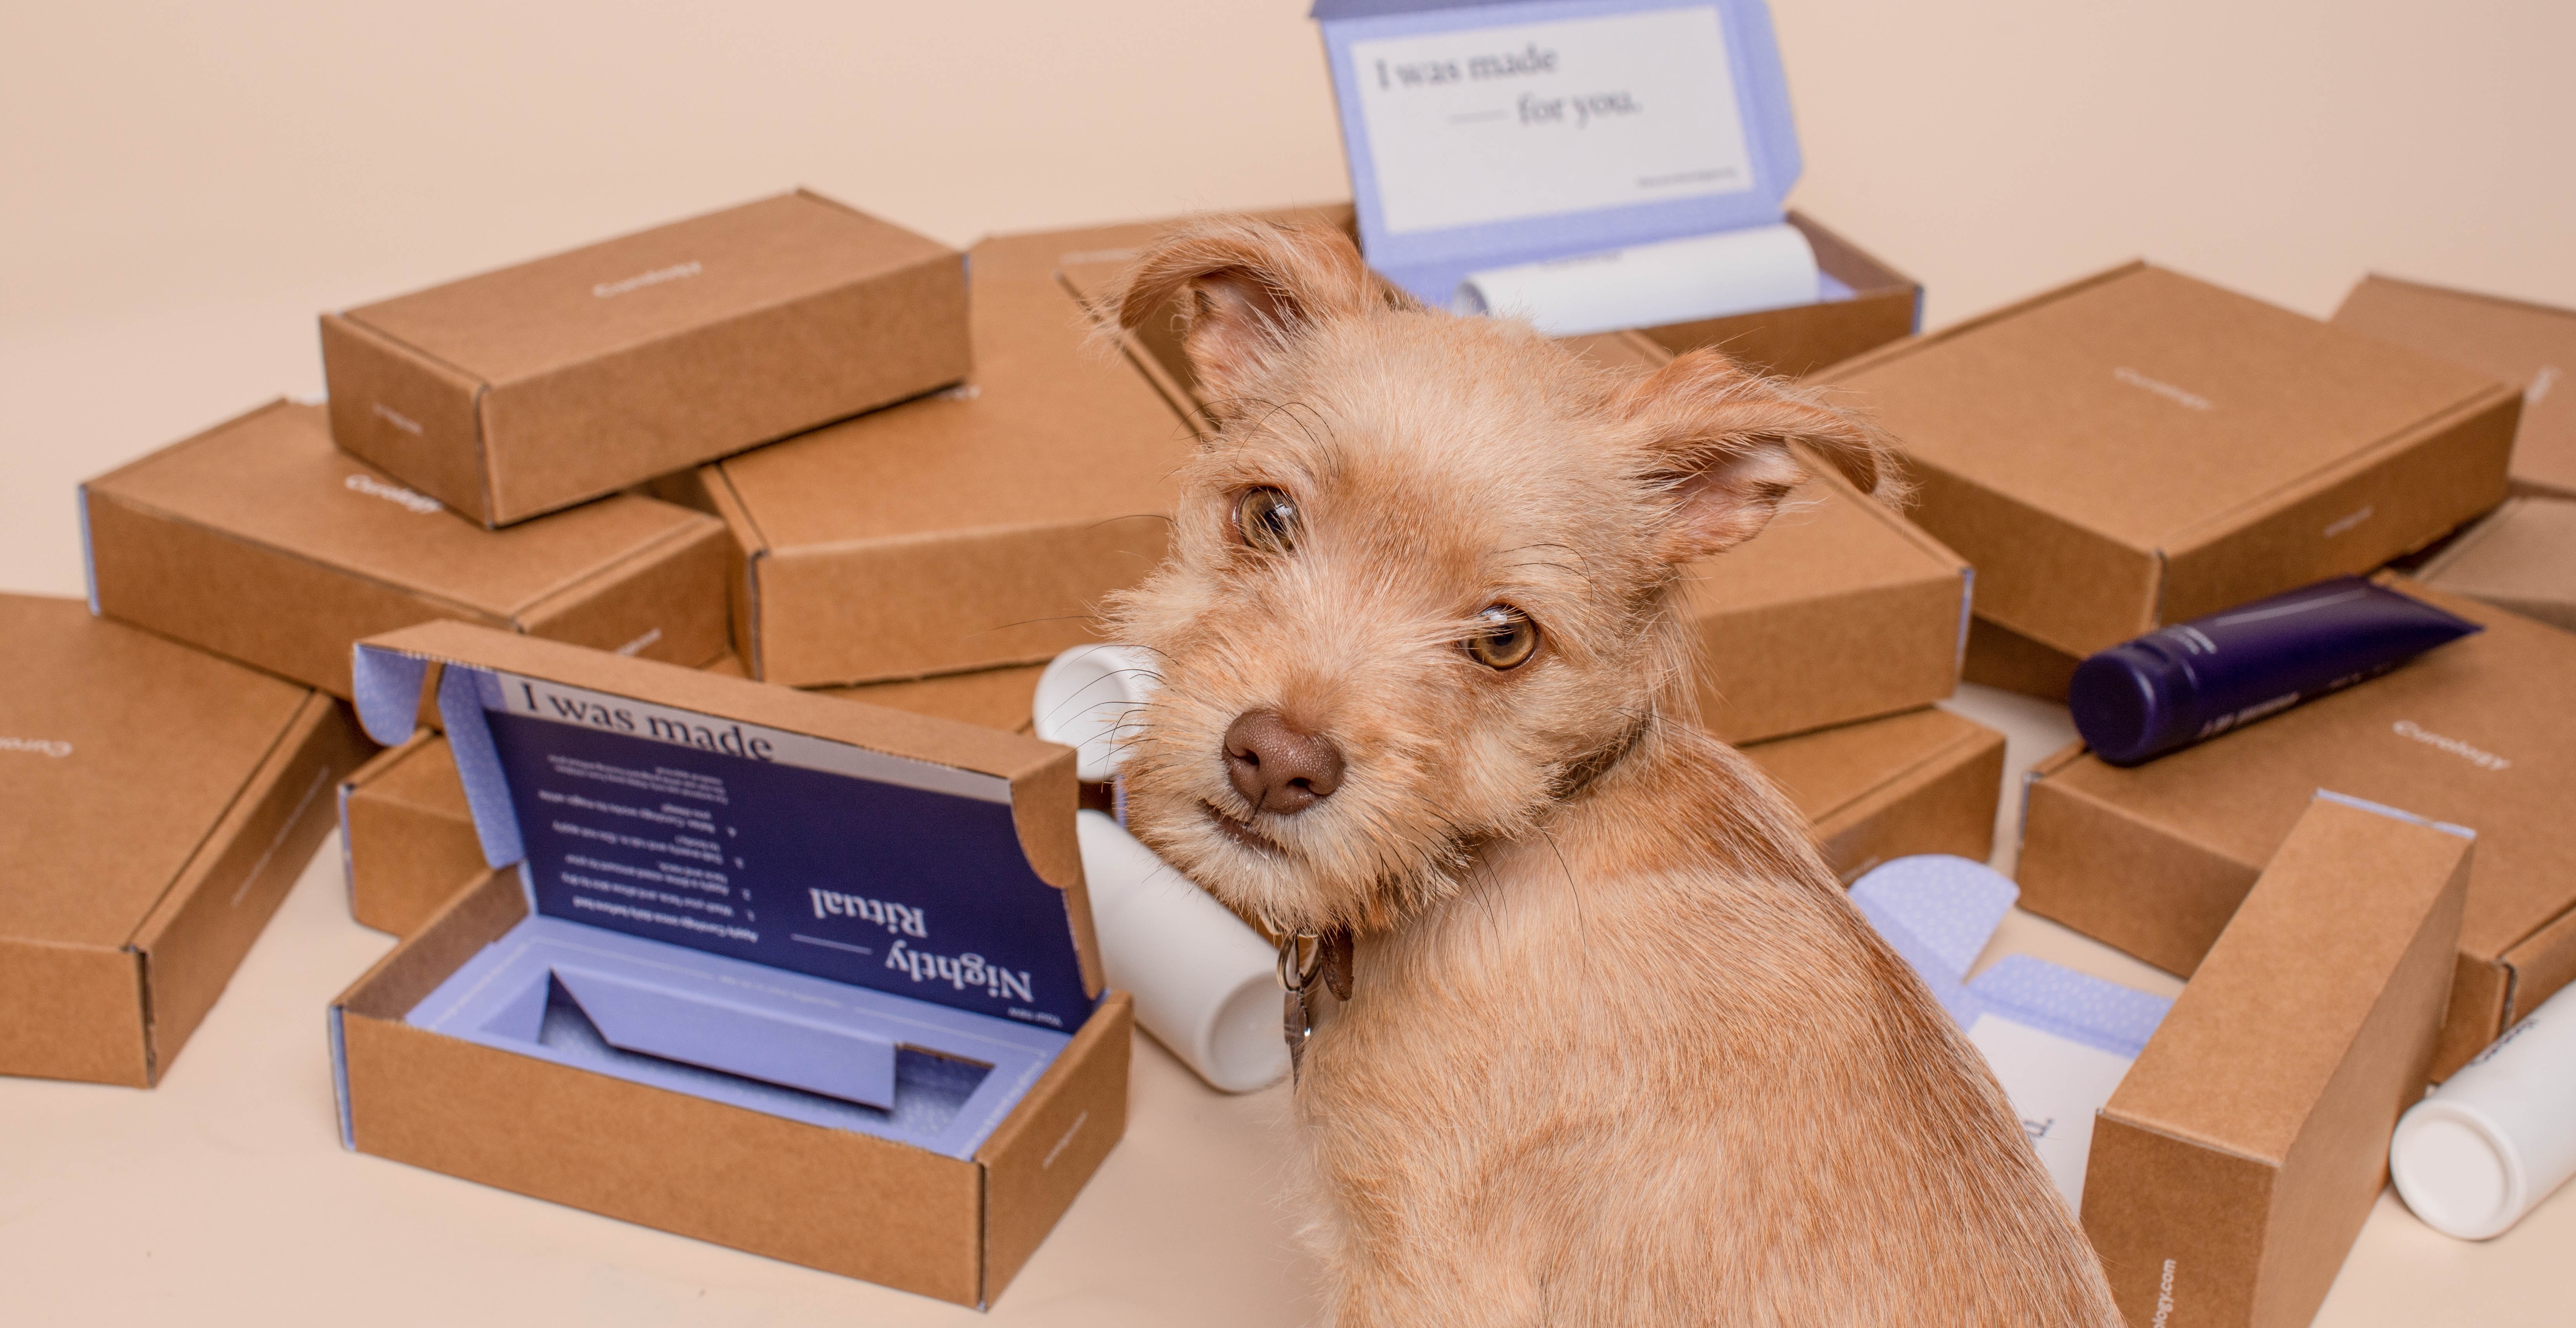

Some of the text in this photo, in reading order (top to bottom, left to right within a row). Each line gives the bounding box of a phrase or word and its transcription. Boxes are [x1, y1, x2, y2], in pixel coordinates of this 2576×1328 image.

[1376, 41, 1560, 90] I was made
[1517, 91, 1563, 127] for
[521, 681, 773, 760] I was made
[809, 887, 928, 938] Ritual
[885, 939, 1034, 1003] Nightly
